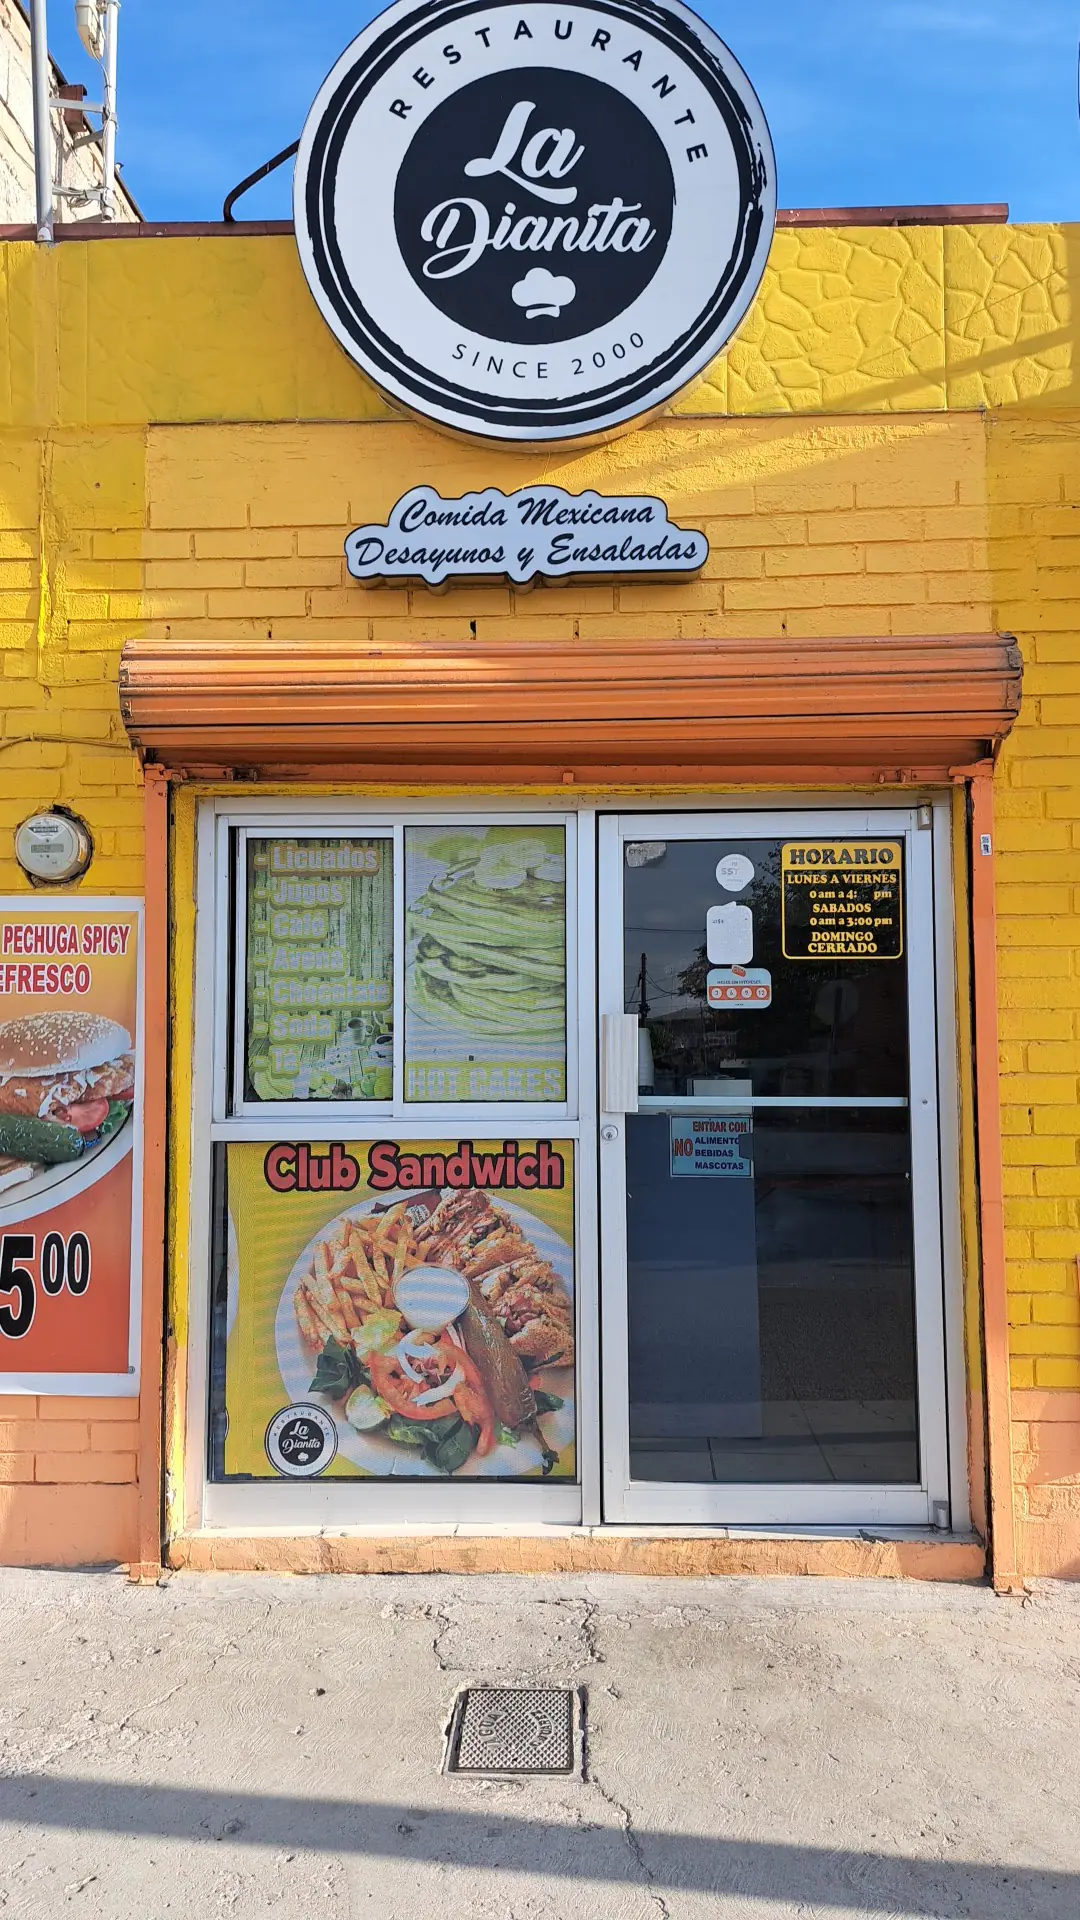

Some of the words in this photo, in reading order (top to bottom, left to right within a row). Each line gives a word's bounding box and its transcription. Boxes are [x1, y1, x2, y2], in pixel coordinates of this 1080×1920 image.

[389, 19, 709, 163] RESTAURANTE
[464, 100, 585, 204] La
[420, 197, 657, 279] Dianita
[452, 343, 548, 379] SINCE
[571, 332, 644, 375] 2000
[399, 499, 508, 533] Comida
[517, 498, 656, 526] Mexicana
[355, 537, 505, 572] Desayunos
[517, 546, 535, 571] y
[547, 533, 698, 565] Ensaladas
[273, 846, 378, 869] Licuados
[789, 848, 894, 865] HORARIO
[787, 874, 828, 884] LUNES
[830, 874, 840, 884] A
[842, 873, 897, 884] VIERNES
[274, 880, 343, 906] Jugos
[818, 891, 836, 899] am
[838, 891, 845, 899] a
[873, 890, 892, 900] pm
[812, 903, 872, 913] SABADOS
[846, 917, 873, 927] 3:00
[873, 918, 892, 927] pm
[3, 925, 79, 954] PECHUGA
[82, 925, 130, 954] SPICY
[807, 942, 878, 953] CERRADO
[811, 931, 874, 942] DOMINGO
[273, 947, 344, 971] Avena
[0, 964, 91, 993] FRESCO
[273, 980, 388, 1003] Chocolate
[273, 1013, 331, 1037] Soda
[407, 1067, 462, 1098] HOT
[469, 1067, 561, 1098] CAKES
[693, 1120, 727, 1132] ENTRAR
[729, 1121, 748, 1133] CON
[674, 1138, 693, 1157] NO
[695, 1149, 734, 1157] BEBIDAS
[264, 1141, 361, 1193] Club
[367, 1140, 565, 1191] Sandwich
[695, 1161, 744, 1170] MASCOTAS
[289, 1420, 310, 1440] La
[282, 1437, 321, 1454] Dianita
